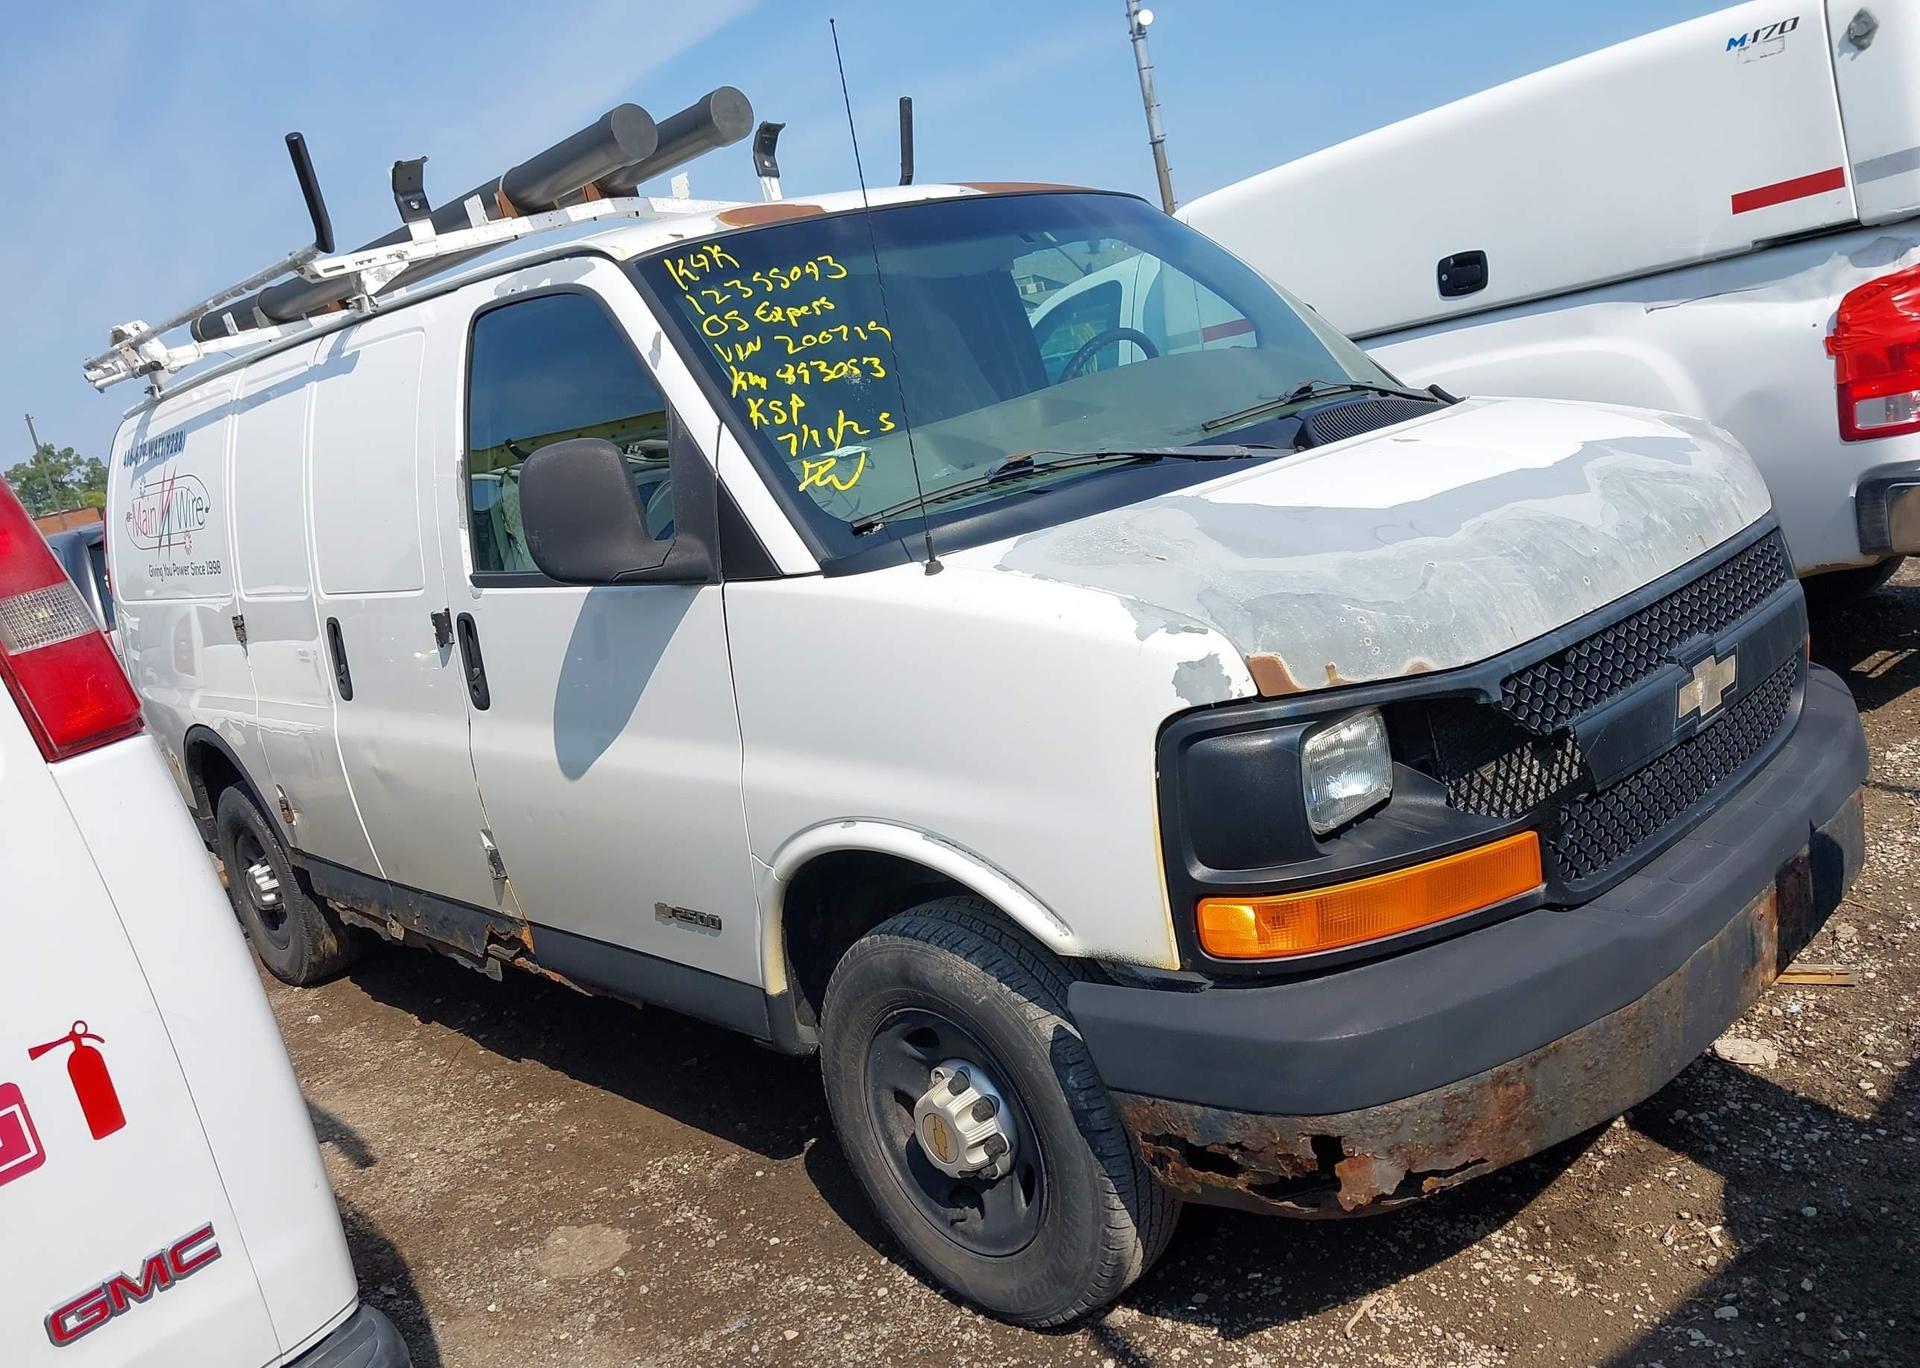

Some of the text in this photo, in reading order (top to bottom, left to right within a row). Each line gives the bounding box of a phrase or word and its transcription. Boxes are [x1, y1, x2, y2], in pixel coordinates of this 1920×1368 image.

[131, 487, 205, 538] Main Wire
[148, 559, 222, 582] Giving You Power Since 1998
[43, 1220, 223, 1349] GMC
